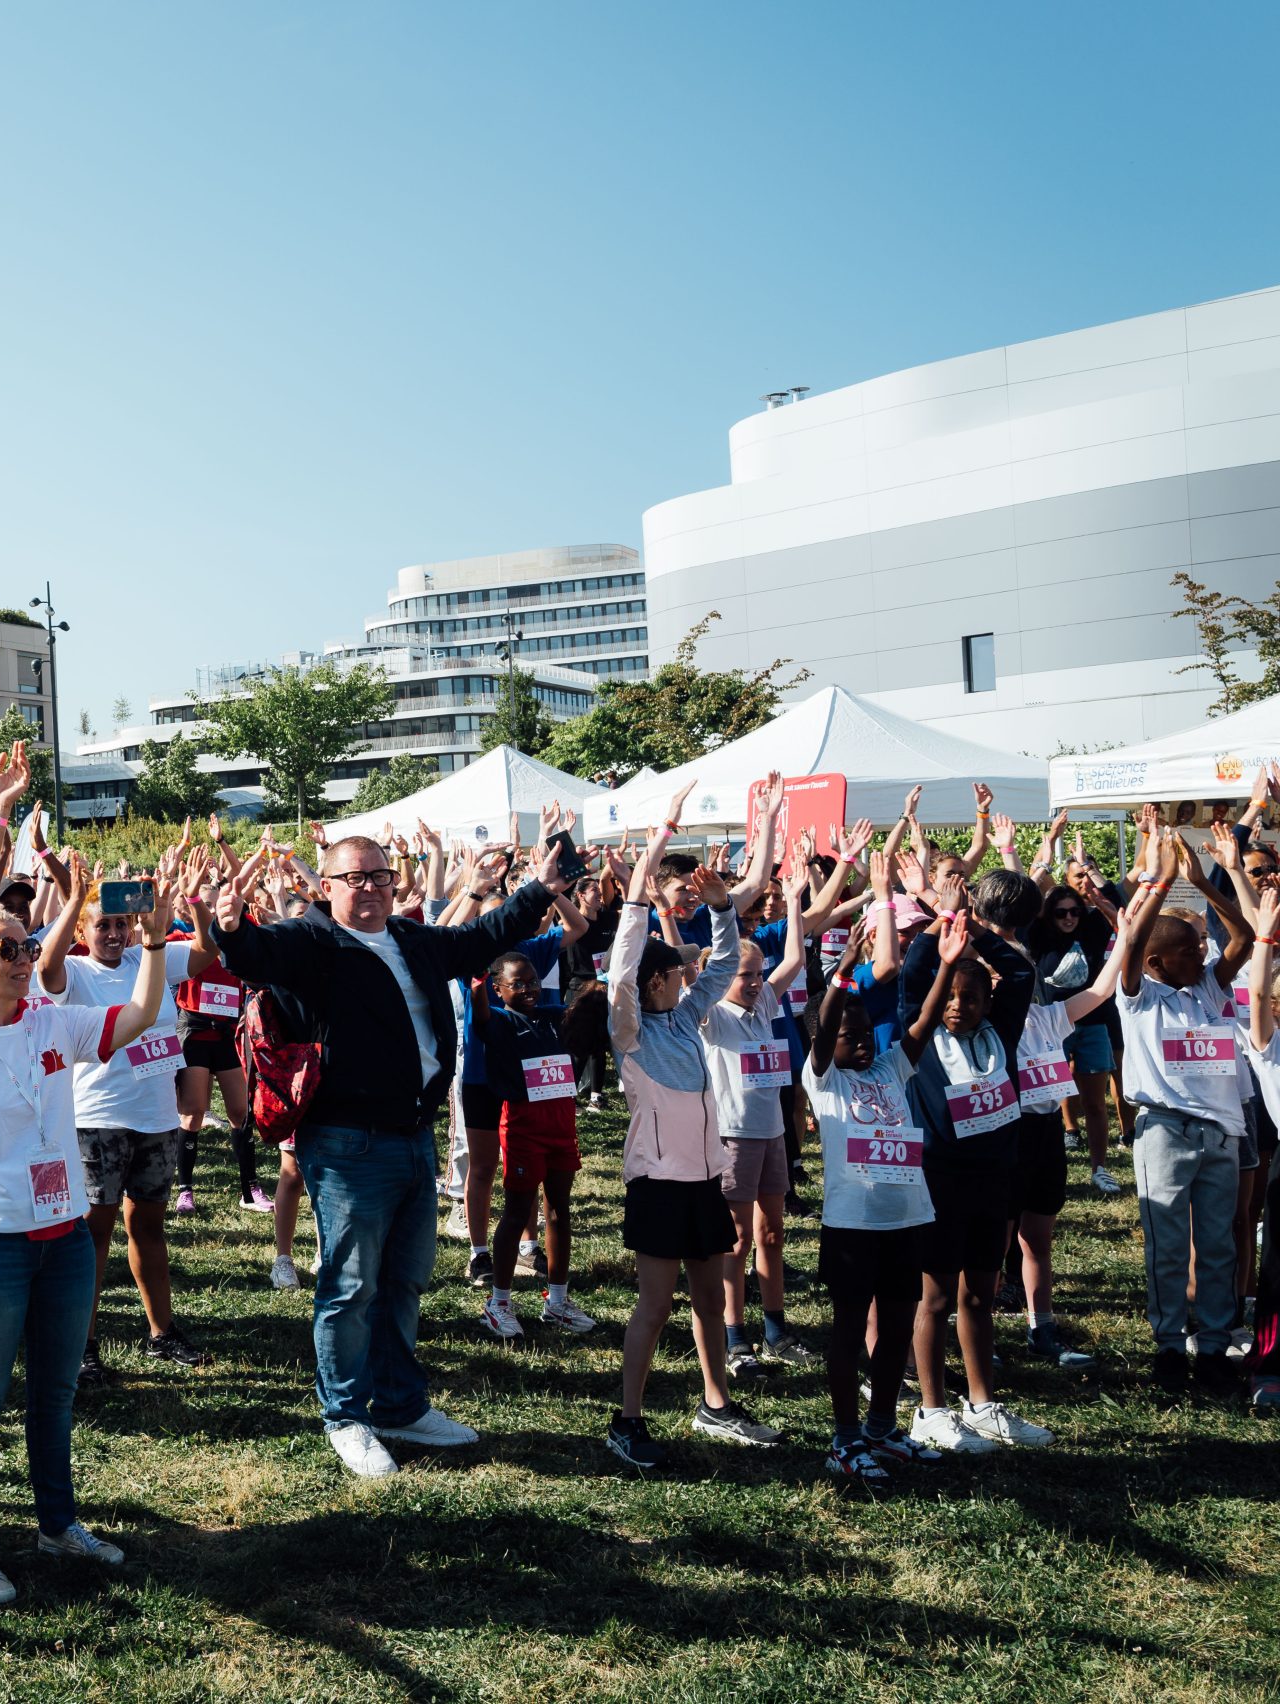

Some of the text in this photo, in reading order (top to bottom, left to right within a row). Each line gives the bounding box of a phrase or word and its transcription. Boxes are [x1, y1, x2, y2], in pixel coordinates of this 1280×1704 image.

[213, 992, 227, 1004] 68
[140, 1039, 169, 1059] 168
[1182, 1040, 1217, 1058] 106
[757, 1052, 780, 1070] 115
[539, 1066, 566, 1084] 296
[1026, 1064, 1058, 1085] 114
[969, 1087, 1004, 1114] 295
[868, 1140, 907, 1162] 290
[36, 1190, 69, 1205] STAFF
